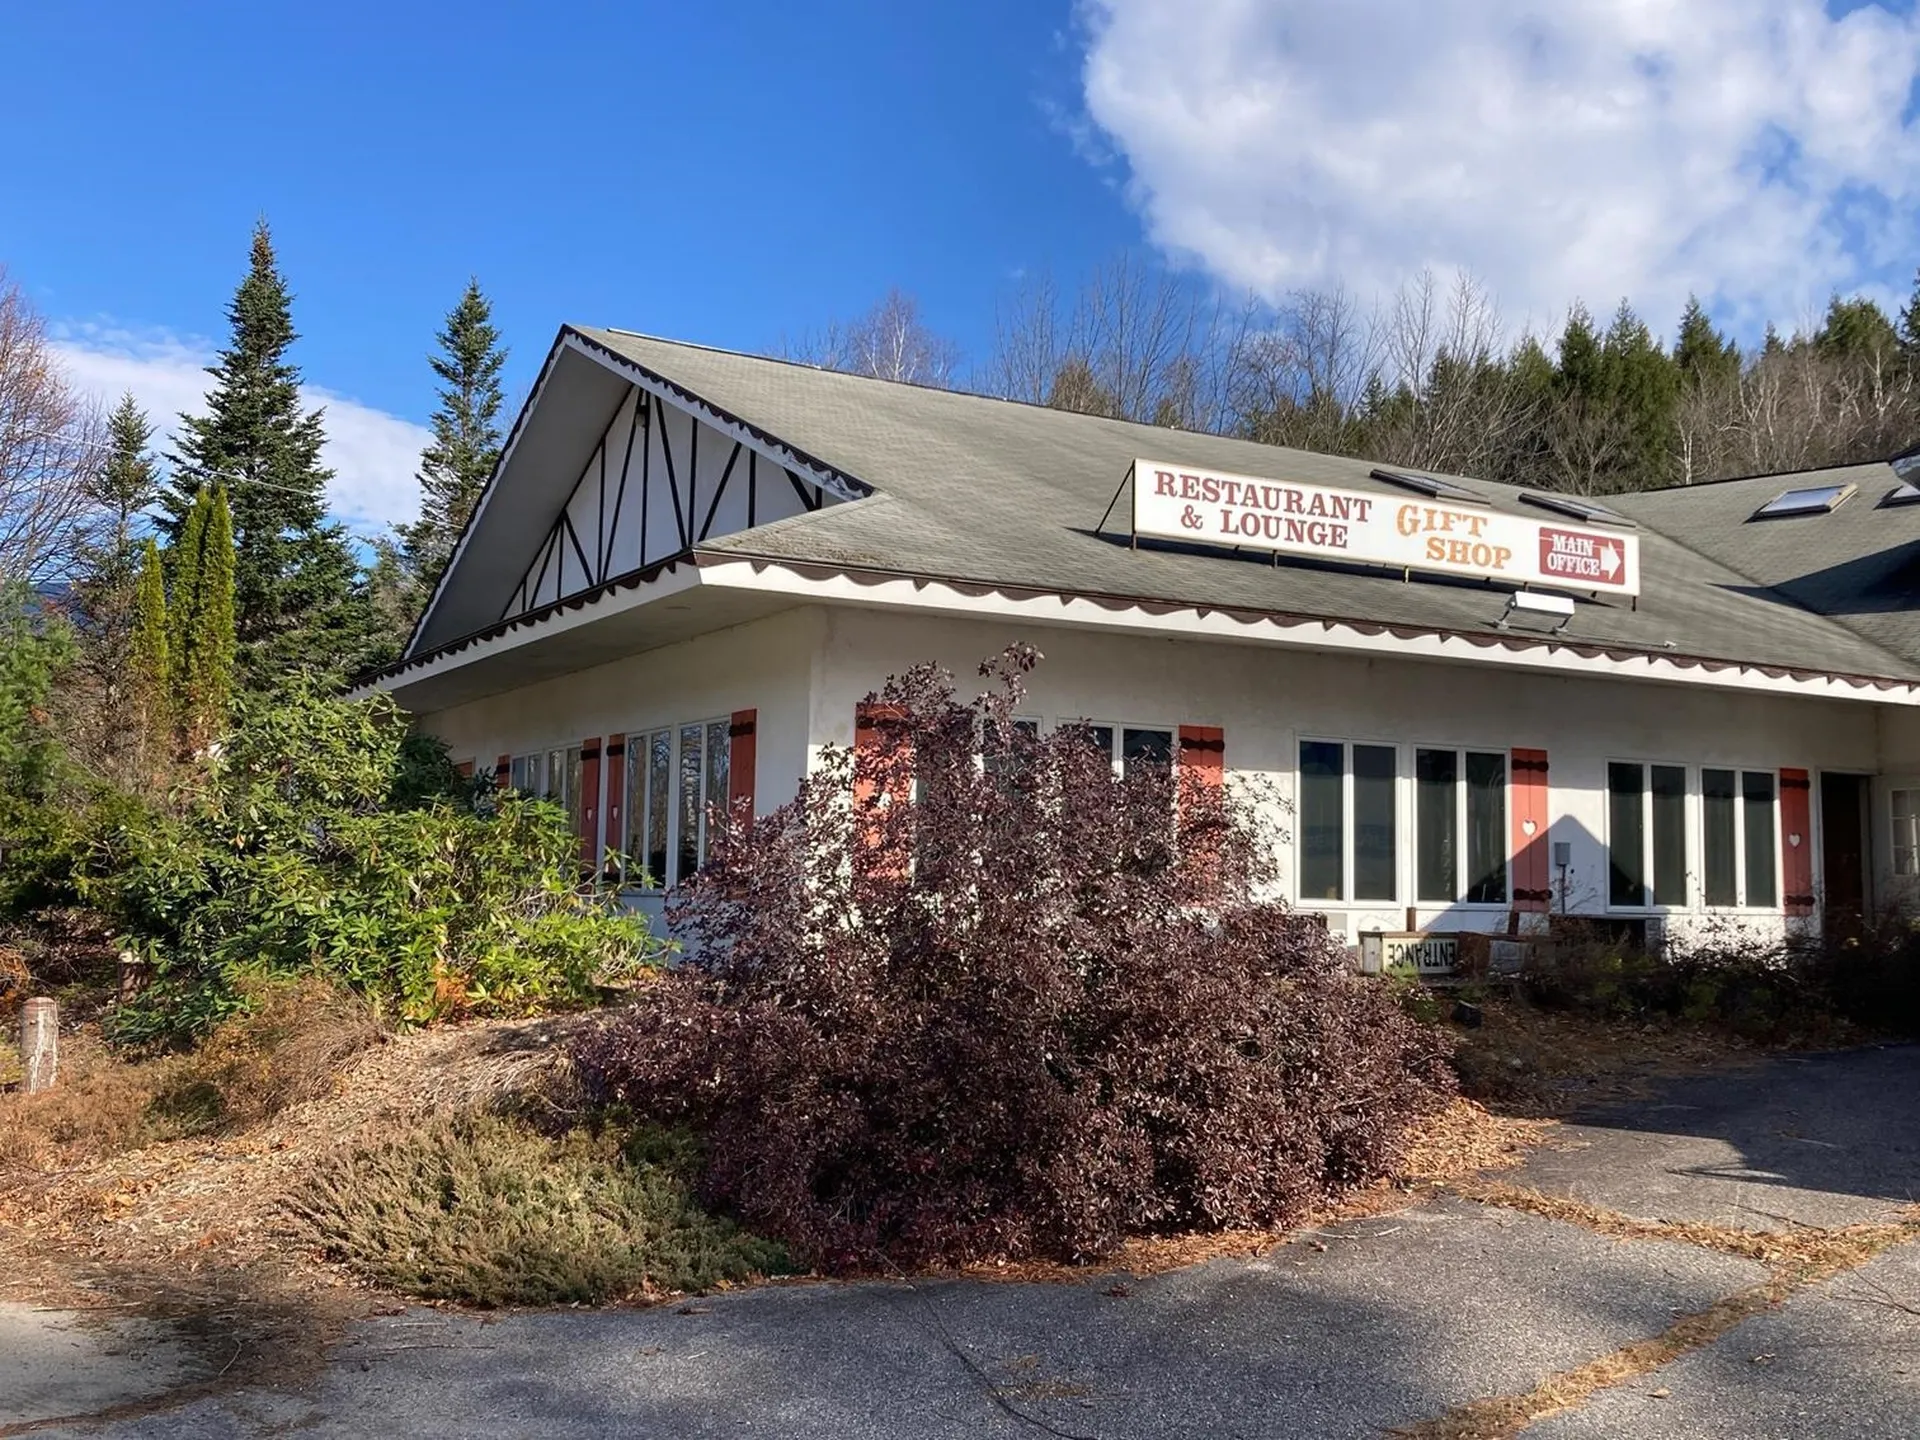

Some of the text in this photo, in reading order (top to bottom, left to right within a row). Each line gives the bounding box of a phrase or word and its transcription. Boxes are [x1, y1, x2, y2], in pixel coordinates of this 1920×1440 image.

[1154, 471, 1372, 523] RESTAURANT
[1180, 504, 1348, 549] & LOUNGE
[1397, 504, 1488, 538] GIFT
[1426, 536, 1512, 569] SHOP
[1552, 534, 1594, 557] MAIN
[1547, 552, 1600, 576] OFFICE
[1388, 943, 1456, 968] ENTRANCE
